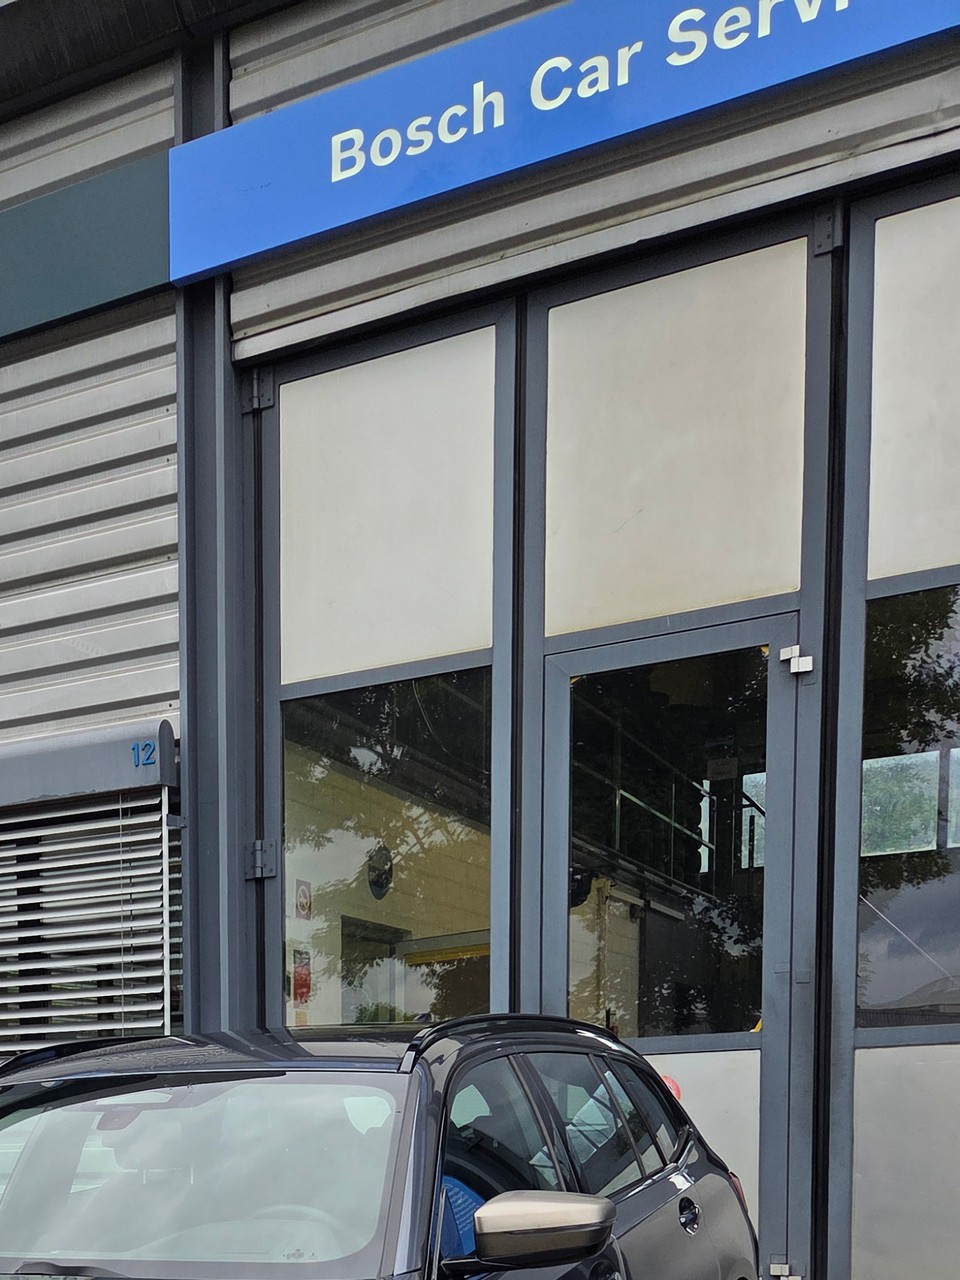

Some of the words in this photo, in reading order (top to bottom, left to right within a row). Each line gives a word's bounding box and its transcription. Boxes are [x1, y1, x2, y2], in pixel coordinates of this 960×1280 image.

[330, 81, 505, 183] Bosch
[530, 41, 643, 111] Car
[666, 0, 849, 66] Serv
[131, 740, 157, 767] 12
